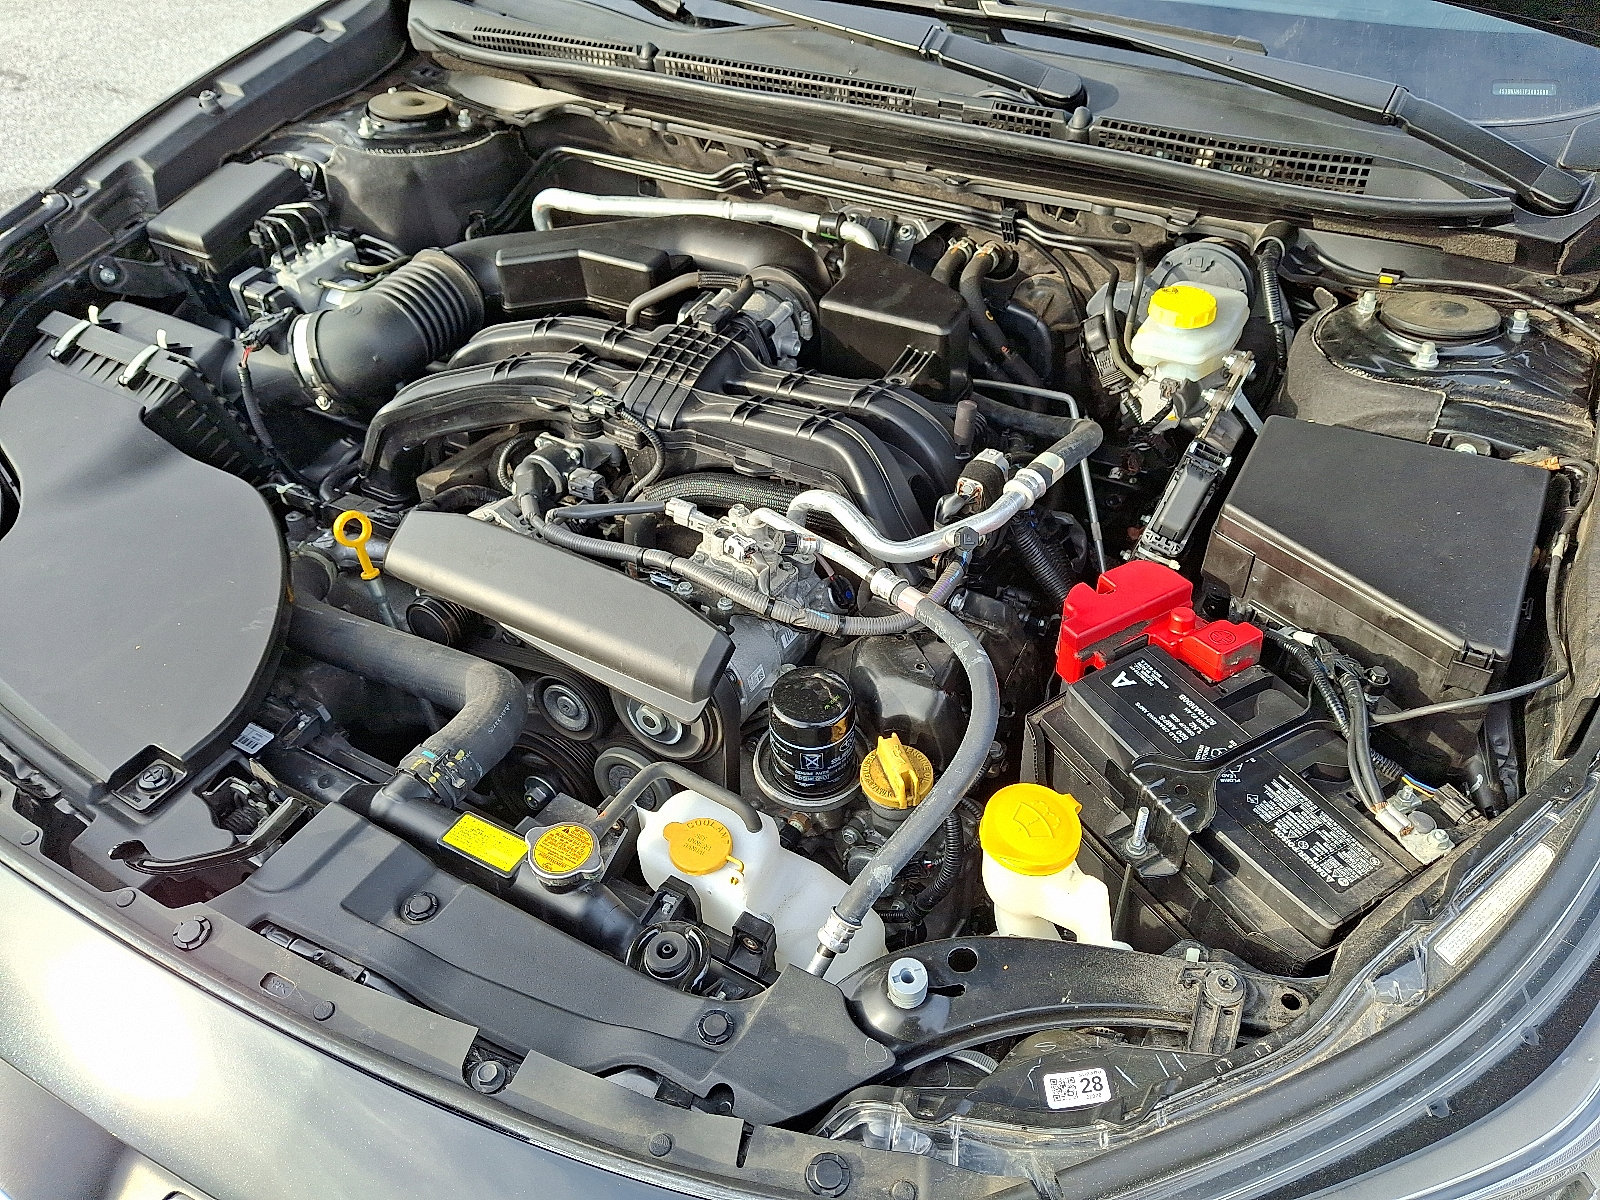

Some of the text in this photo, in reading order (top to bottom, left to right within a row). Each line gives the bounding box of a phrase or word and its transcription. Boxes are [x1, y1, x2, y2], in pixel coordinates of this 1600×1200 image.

[1111, 670, 1138, 688] A
[1159, 714, 1179, 731] AMPS
[1168, 731, 1183, 744] COLD
[905, 746, 931, 771] ENGINE
[1080, 1076, 1103, 1093] 28
